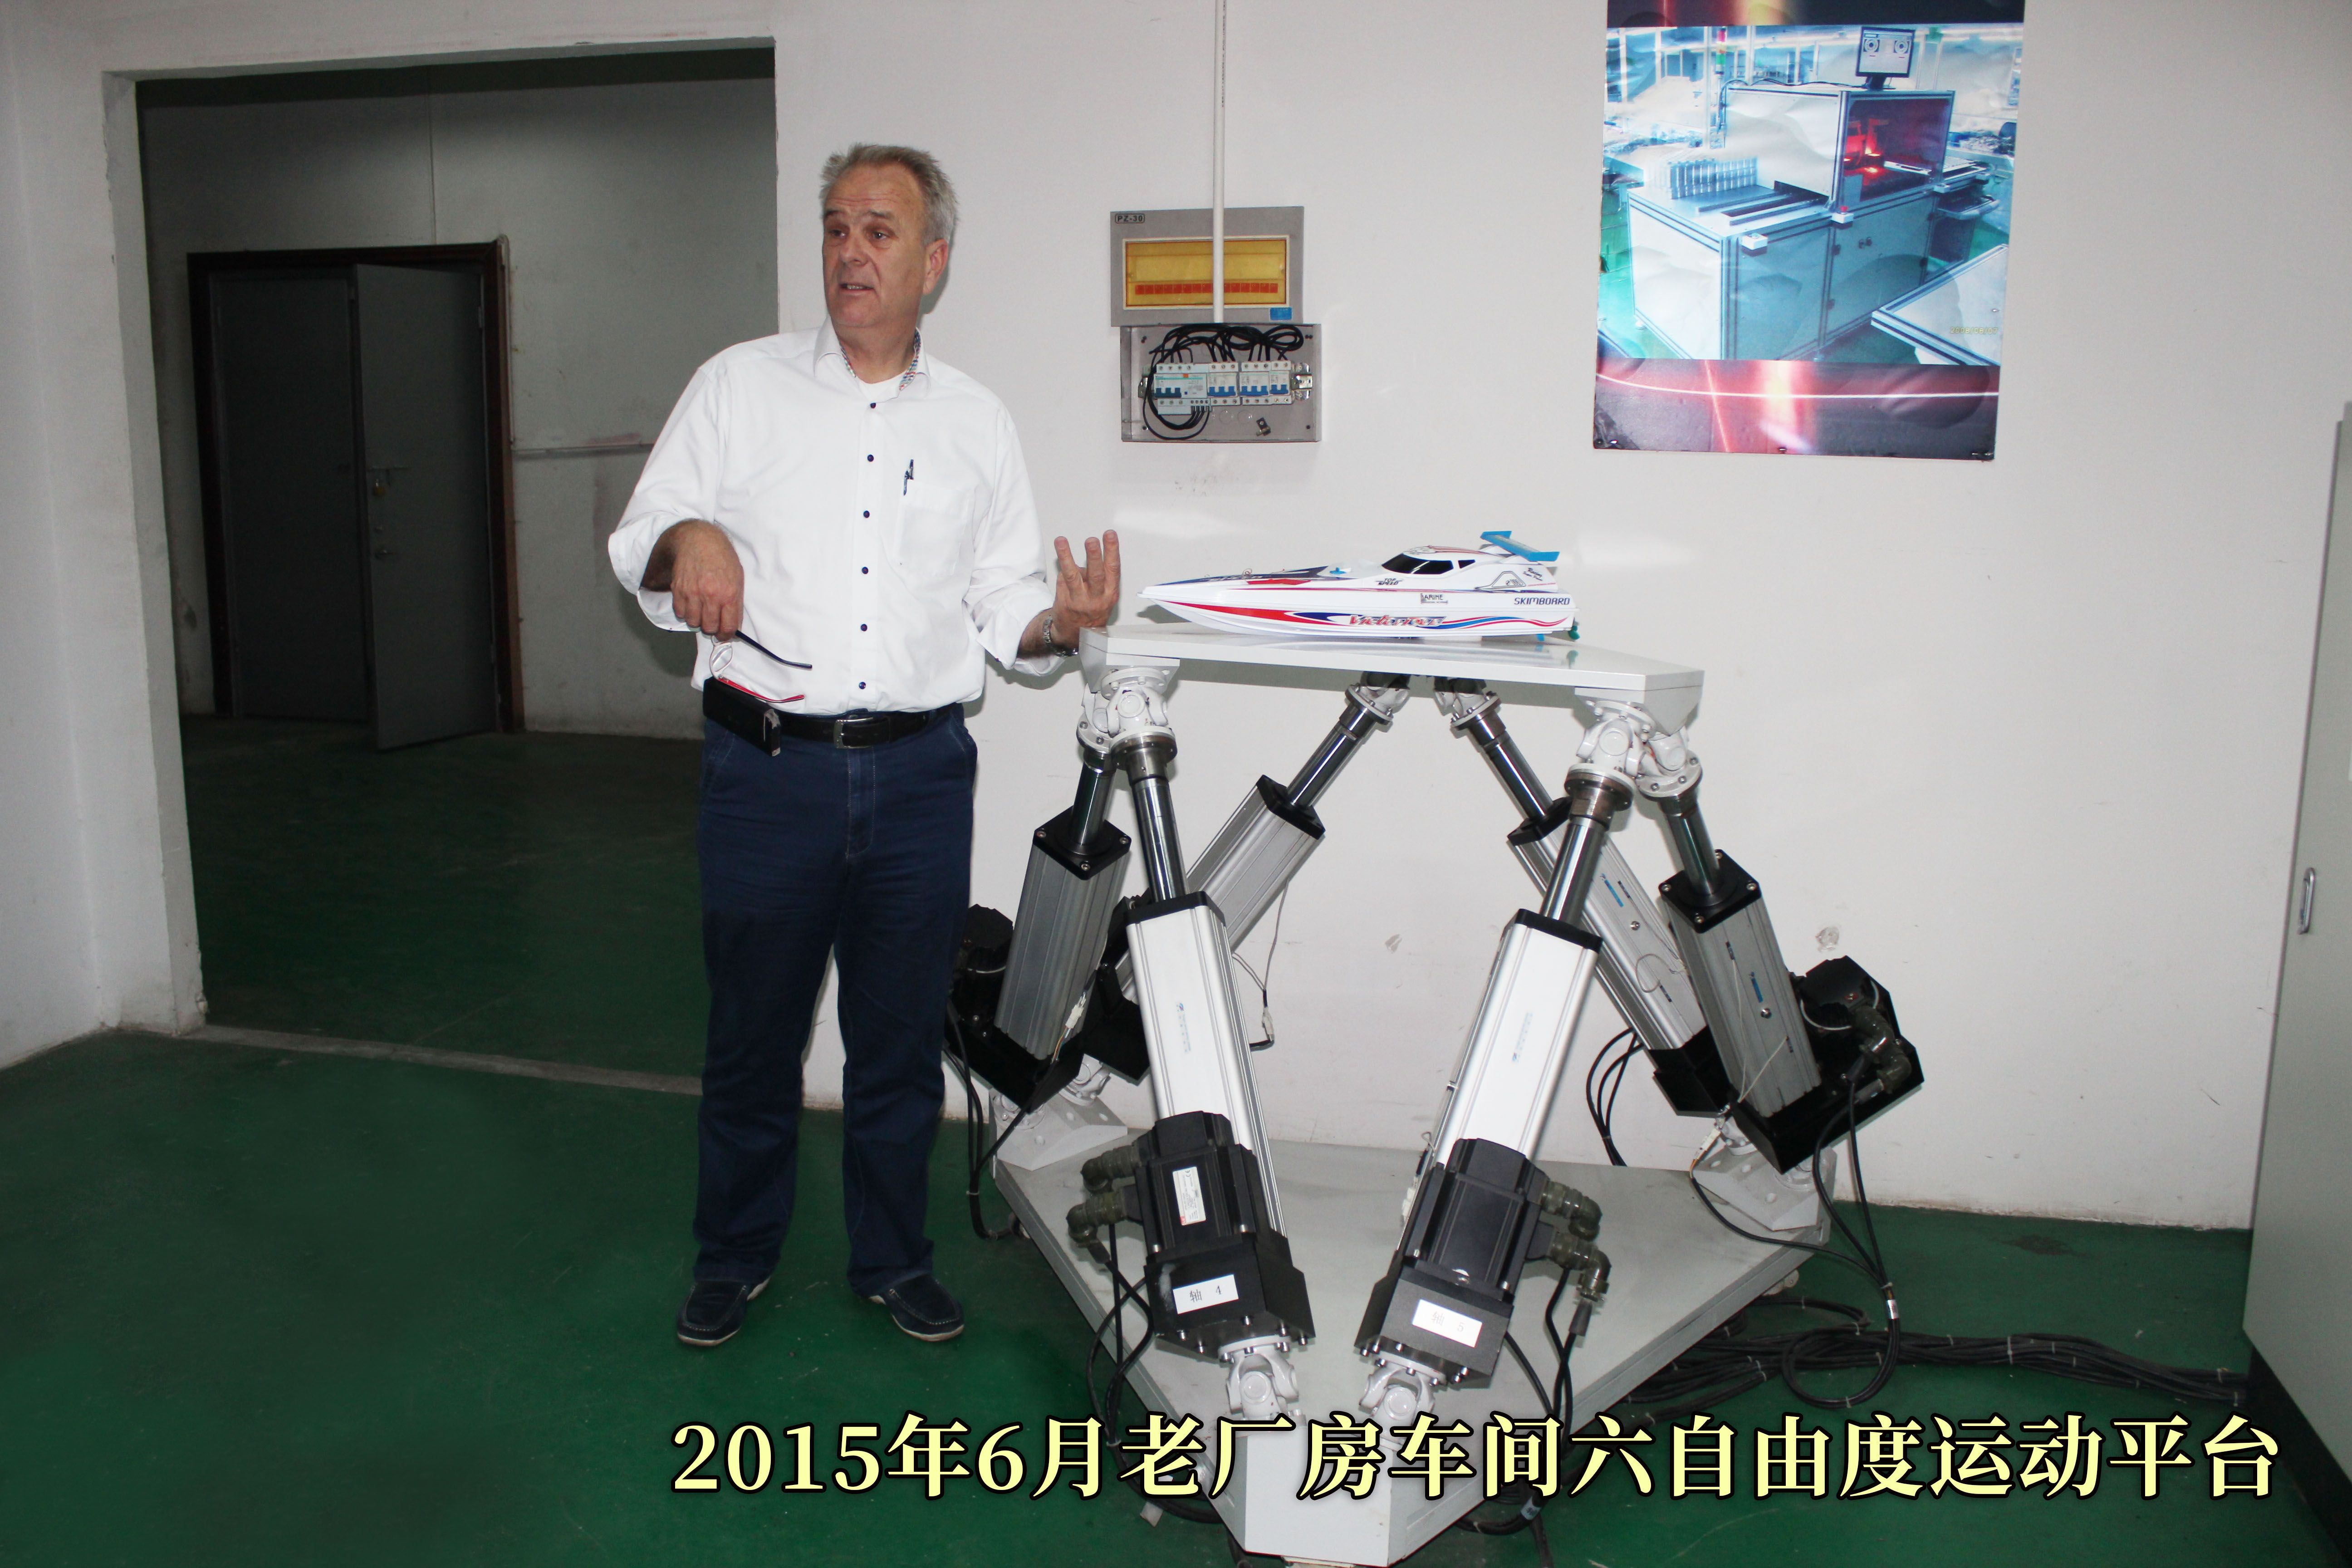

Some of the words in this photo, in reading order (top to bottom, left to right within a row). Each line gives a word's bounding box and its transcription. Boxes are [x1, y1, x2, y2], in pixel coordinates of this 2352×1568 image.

[1189, 1289, 1202, 1303] 轴
[1215, 1285, 1221, 1295] 4
[1431, 1312, 1445, 1326] 轴
[1457, 1322, 1465, 1332] 5
